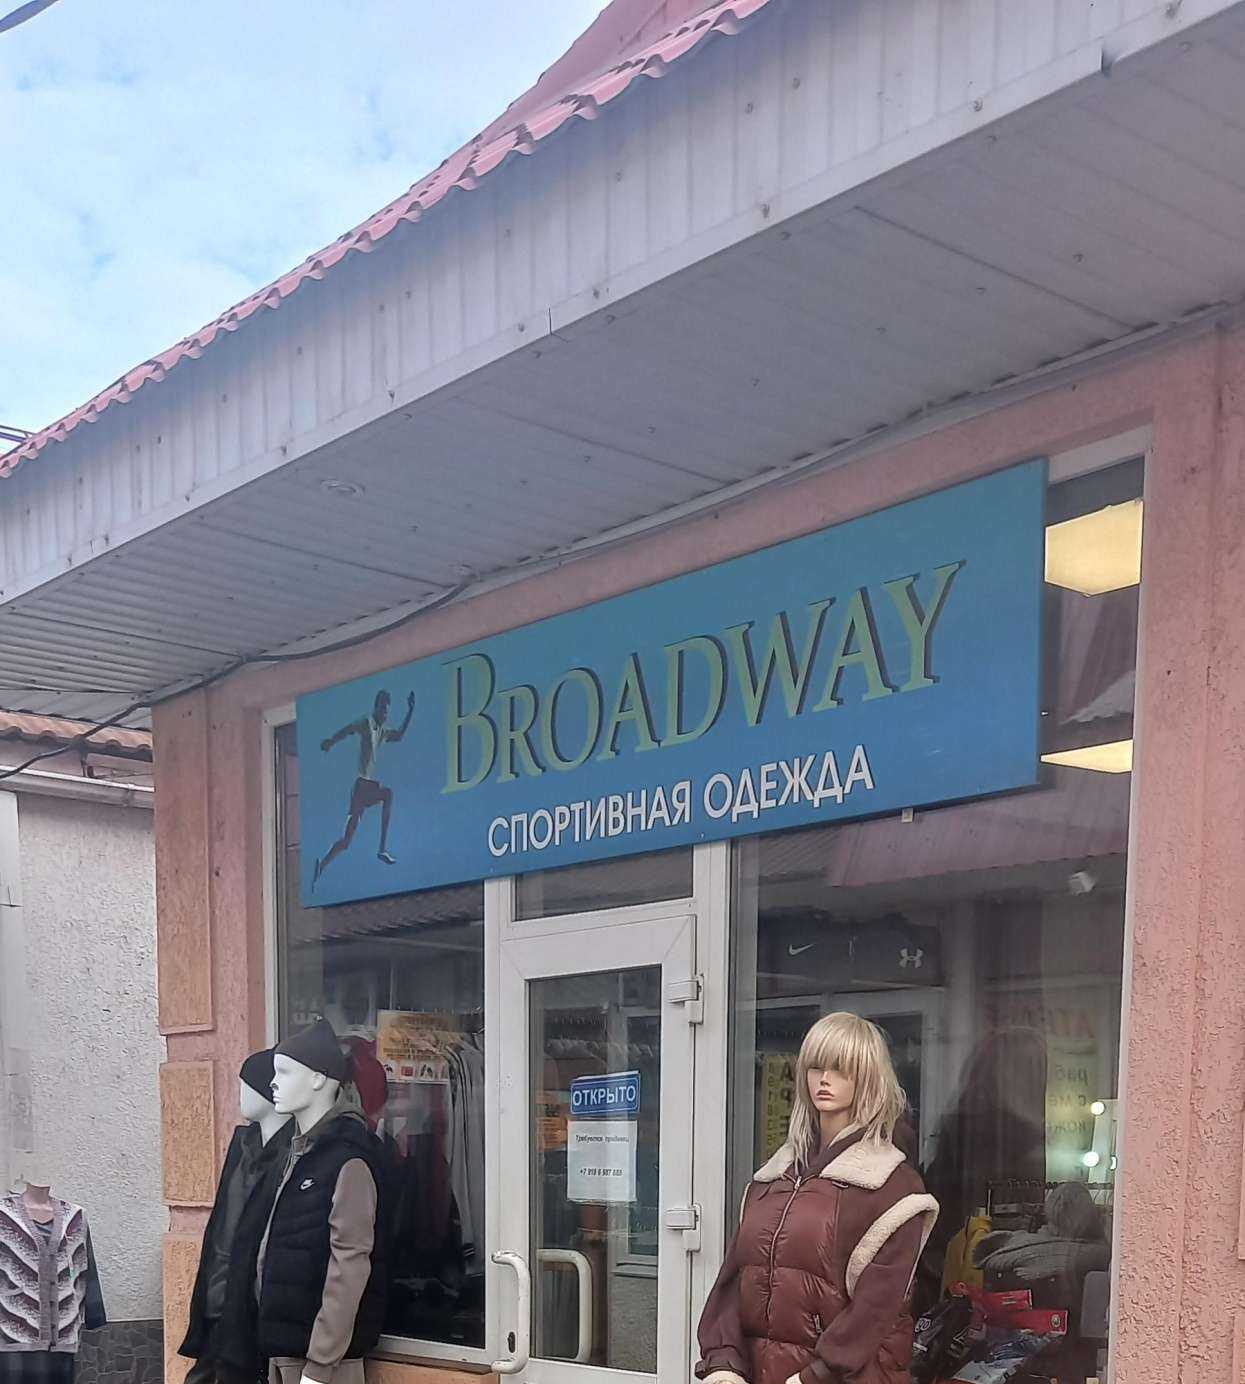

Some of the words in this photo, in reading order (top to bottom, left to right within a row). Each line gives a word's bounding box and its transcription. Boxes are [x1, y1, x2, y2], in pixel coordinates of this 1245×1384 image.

[440, 559, 966, 794] BROADWAY
[488, 780, 691, 858] СПОРТИВНАЯ
[703, 744, 875, 820] ОДЕЖДА
[572, 1085, 636, 1107] ОТКРЫТО
